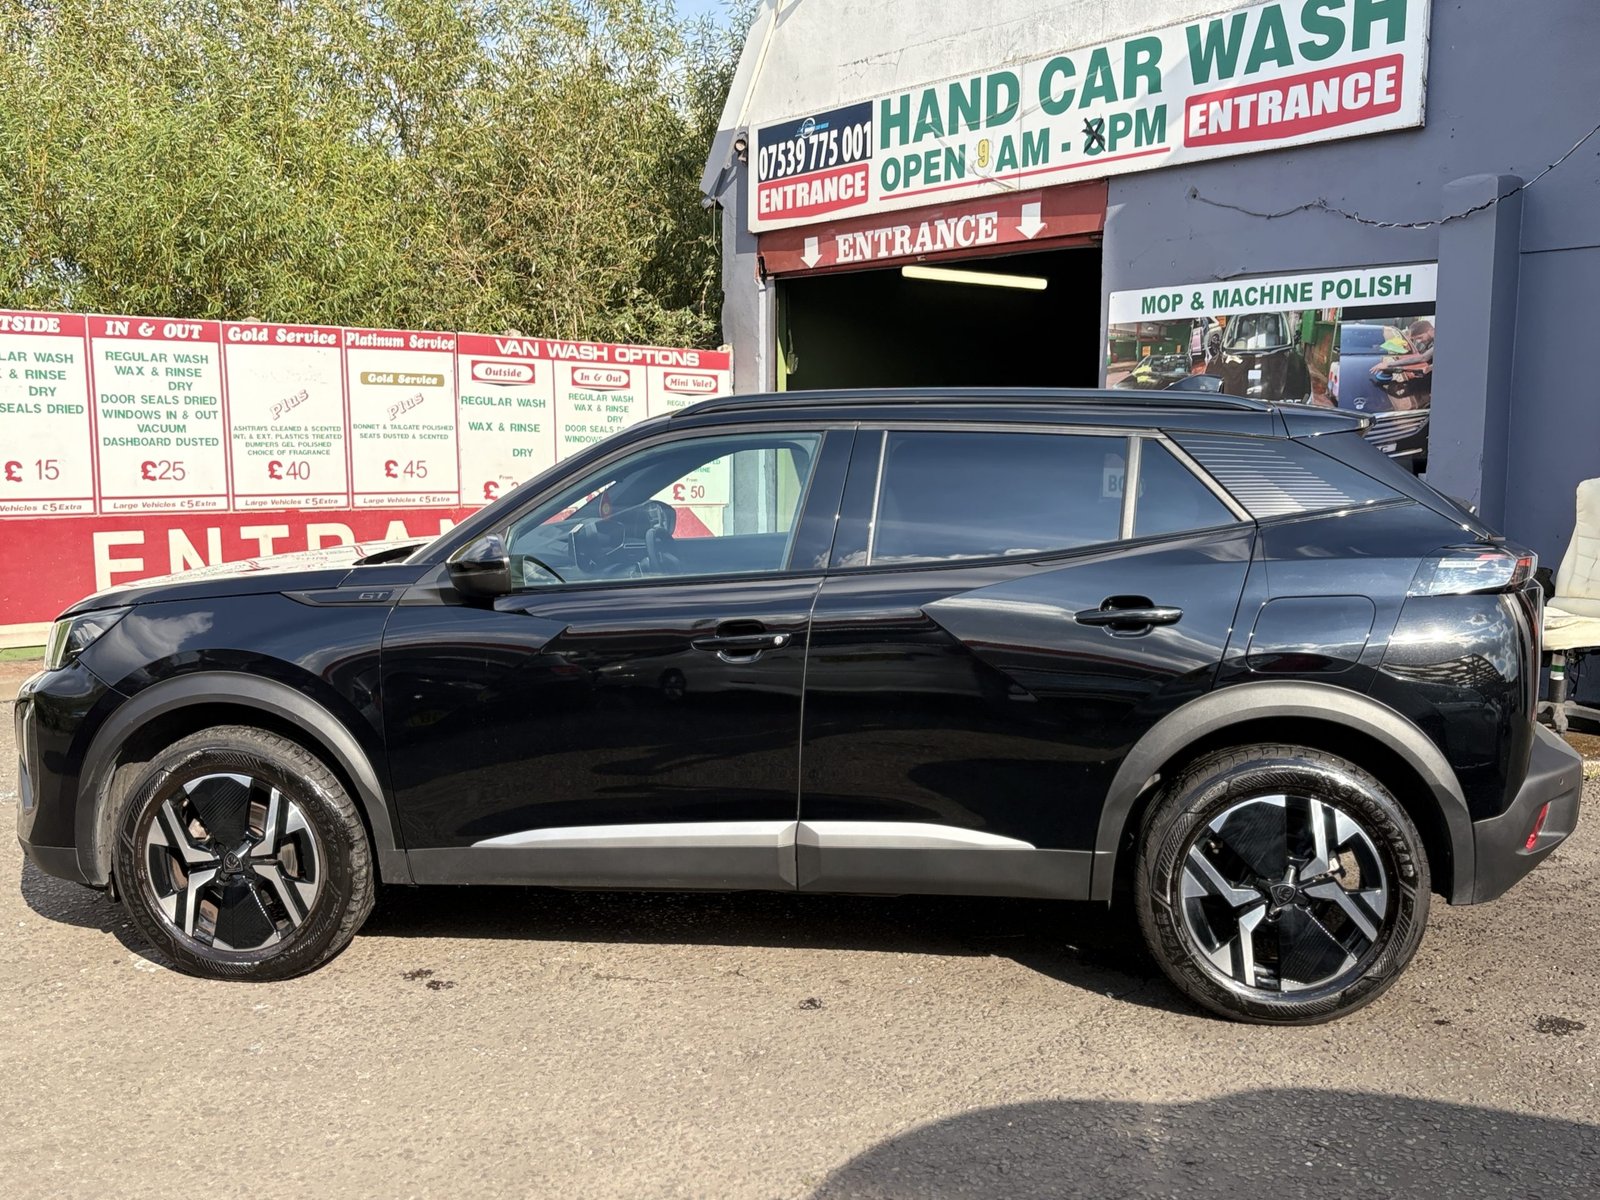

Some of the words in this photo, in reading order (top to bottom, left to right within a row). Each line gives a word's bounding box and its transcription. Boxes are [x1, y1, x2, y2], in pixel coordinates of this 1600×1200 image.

[879, 70, 1021, 150] HAND
[1038, 37, 1163, 117] CAR
[1185, 0, 1406, 86] WASH
[1188, 65, 1398, 139] ENTRANCE
[759, 138, 806, 181] 07539
[809, 129, 838, 170] 775
[842, 121, 871, 162] 001
[881, 143, 966, 193] OPEN
[760, 171, 866, 214] ENTRANCE
[835, 211, 998, 264] ENTRANCE
[1141, 293, 1183, 315] MOP
[1190, 292, 1205, 310] &
[1212, 281, 1313, 309] MACHINE
[1321, 273, 1412, 301] POLISH
[105, 320, 130, 336] IN
[138, 322, 156, 337] &
[163, 323, 203, 339] OUT
[227, 327, 269, 342] Gold
[275, 328, 337, 345] Service
[346, 332, 404, 348] Platinum
[409, 335, 454, 350] Service
[33, 352, 74, 364] WASH
[105, 351, 168, 363] REGULAR
[173, 354, 209, 364] WASH
[496, 339, 539, 357] VAN
[549, 341, 608, 359] WASH
[615, 346, 699, 367] OPTIONS
[9, 368, 18, 379] &
[25, 369, 67, 380] RINSE
[114, 365, 145, 376] WAX
[151, 367, 160, 376] &
[165, 367, 202, 377] RINSE
[484, 368, 522, 378] Outside
[580, 372, 590, 381] In
[594, 373, 601, 381] &
[606, 373, 622, 382] Out
[367, 374, 394, 383] Gold
[397, 375, 437, 385] Service
[670, 378, 688, 387] Mini
[28, 385, 57, 397] DRY
[168, 381, 193, 391] DRY
[100, 394, 136, 404] DOOR
[141, 395, 179, 405] SEALS
[184, 395, 217, 405] DRIED
[461, 396, 512, 406] REGULAR
[517, 398, 546, 408] WASH
[568, 393, 608, 402] REGULAR
[611, 394, 634, 402] WASH
[0, 403, 42, 414] SEALS
[47, 404, 84, 414] DRIED
[269, 388, 310, 421] Plus
[387, 392, 424, 420] Plus
[574, 404, 592, 412] WAX
[102, 409, 161, 419] WINDOWS
[166, 410, 177, 419] IN
[182, 410, 189, 419] &
[195, 410, 218, 419] OUT
[137, 424, 187, 433] VACUUM
[468, 422, 492, 431] WAX
[498, 422, 505, 432] &
[510, 423, 540, 432] RINSE
[590, 425, 614, 433] SEALS
[103, 437, 171, 447] DASHBOARD
[176, 437, 219, 447] DUSTED
[512, 448, 534, 457] DRY
[140, 460, 186, 481] £25
[113, 502, 138, 510] Large
[358, 592, 388, 600] GT
